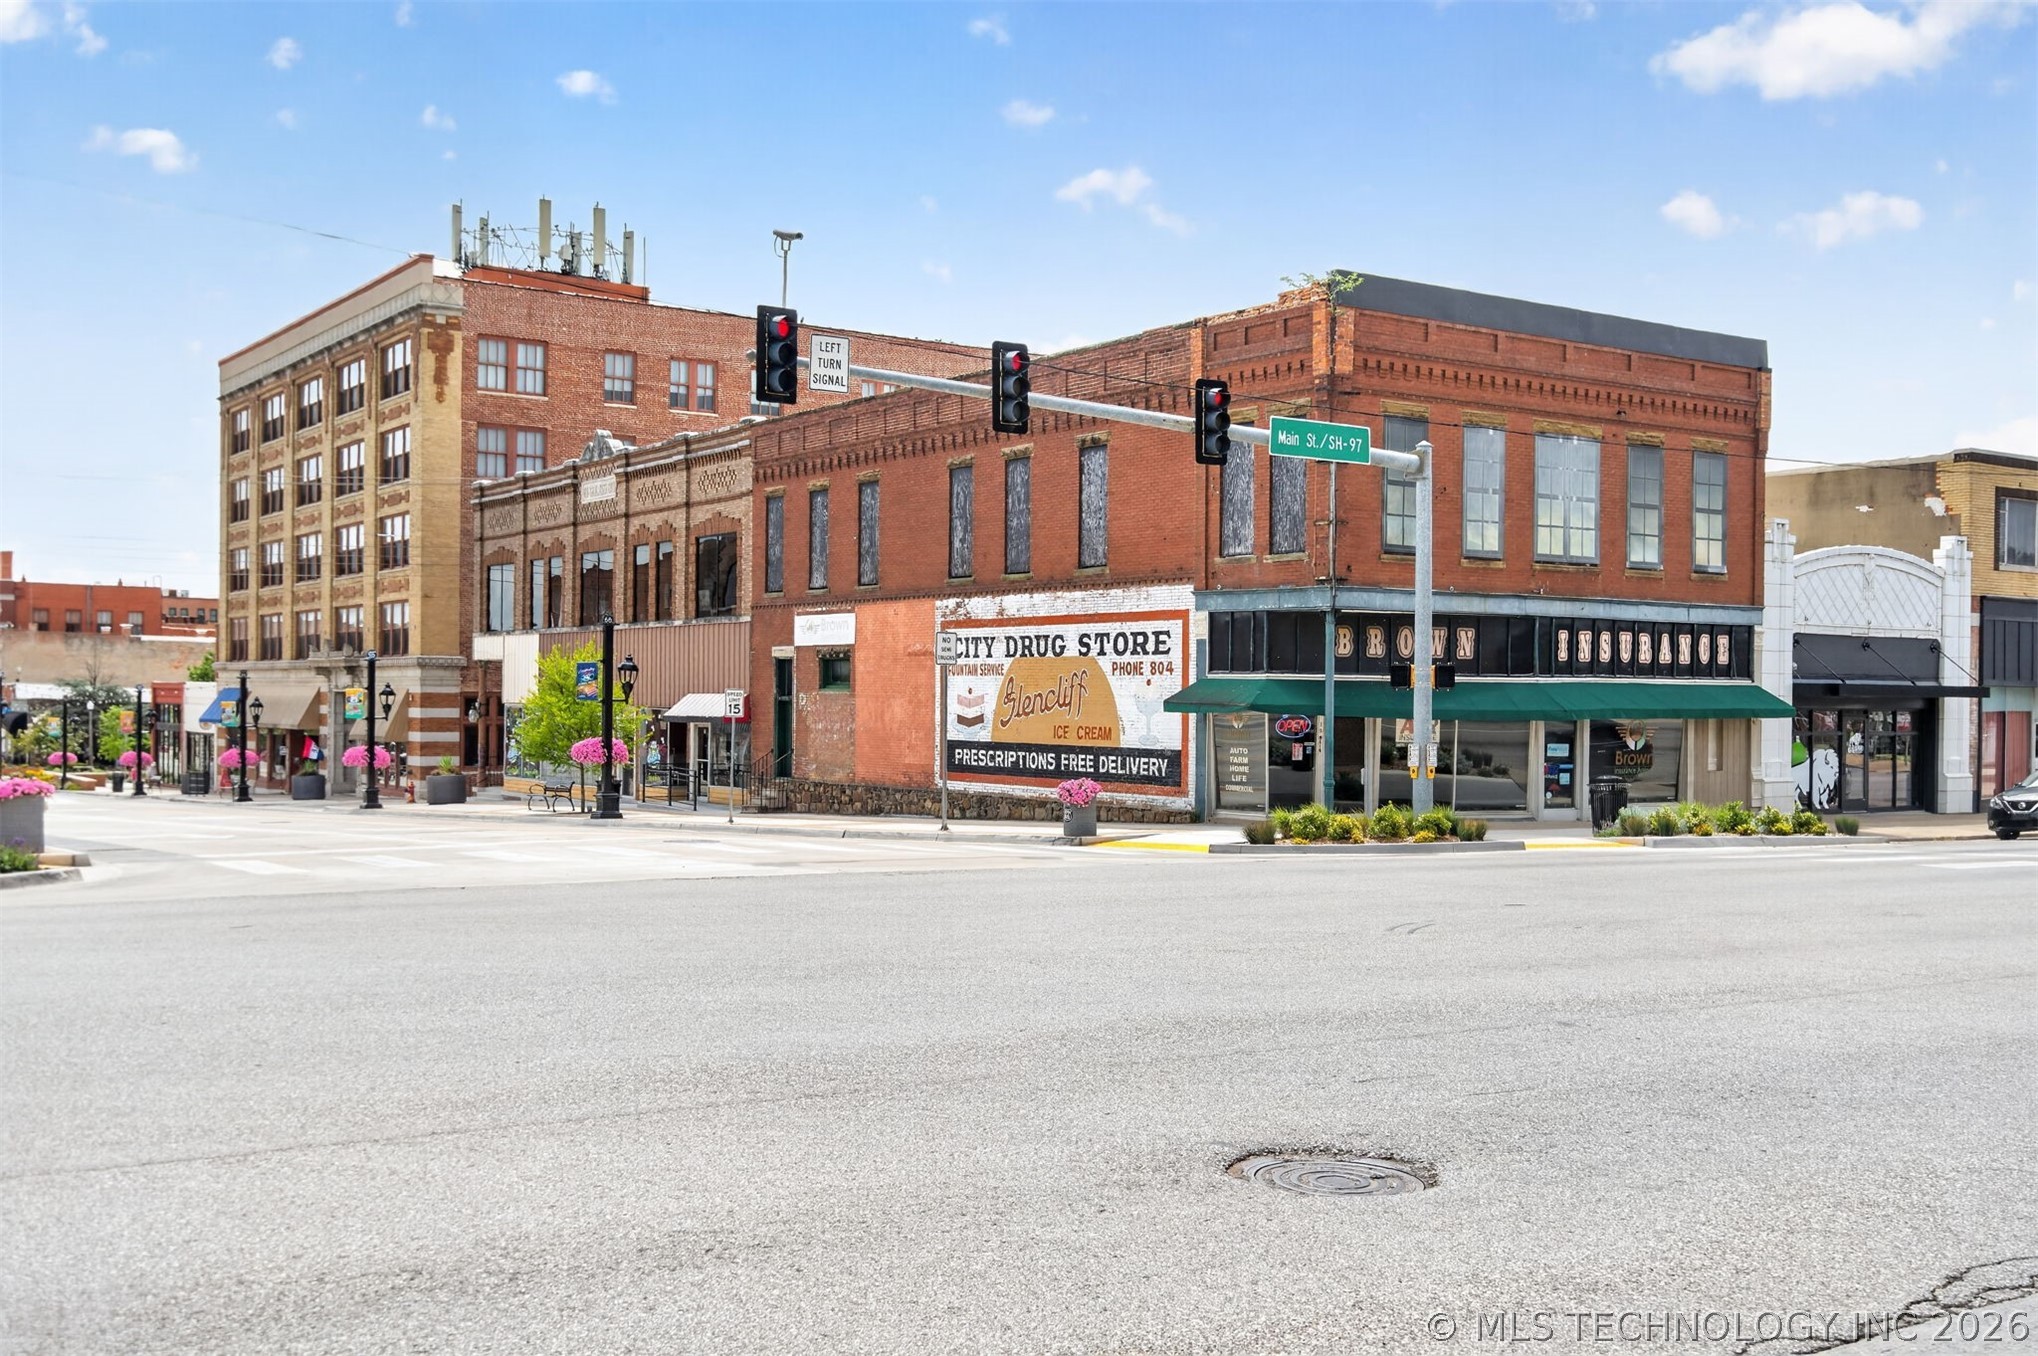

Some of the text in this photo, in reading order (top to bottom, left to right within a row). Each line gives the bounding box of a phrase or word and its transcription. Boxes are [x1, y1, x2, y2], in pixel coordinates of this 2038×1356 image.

[819, 341, 841, 354] LEFT
[818, 357, 842, 370] TURN
[812, 373, 846, 387] SIGNAL
[1278, 430, 1363, 453] Main St./SH-97
[820, 618, 849, 632] Brown
[956, 630, 1172, 659] CITY DRUG STORE
[1334, 625, 1475, 660] BROWN
[1557, 629, 1730, 665] INSURANCE
[947, 663, 1005, 677] FOUNTAIN SERVICE
[1111, 661, 1174, 676] PHONE 804
[999, 668, 1089, 728] Glencliff
[728, 704, 741, 714] 15
[1278, 719, 1309, 733] OPEN
[1053, 726, 1113, 741] ICE CREAM
[1229, 747, 1249, 755] AUTO
[954, 748, 1169, 777] PRESCRIPTIONS FREE DELIVERY
[1229, 756, 1249, 764] FARM
[1229, 765, 1250, 773] HOME
[1231, 774, 1247, 782] LIFE
[1225, 784, 1254, 793] COMMERCIAL
